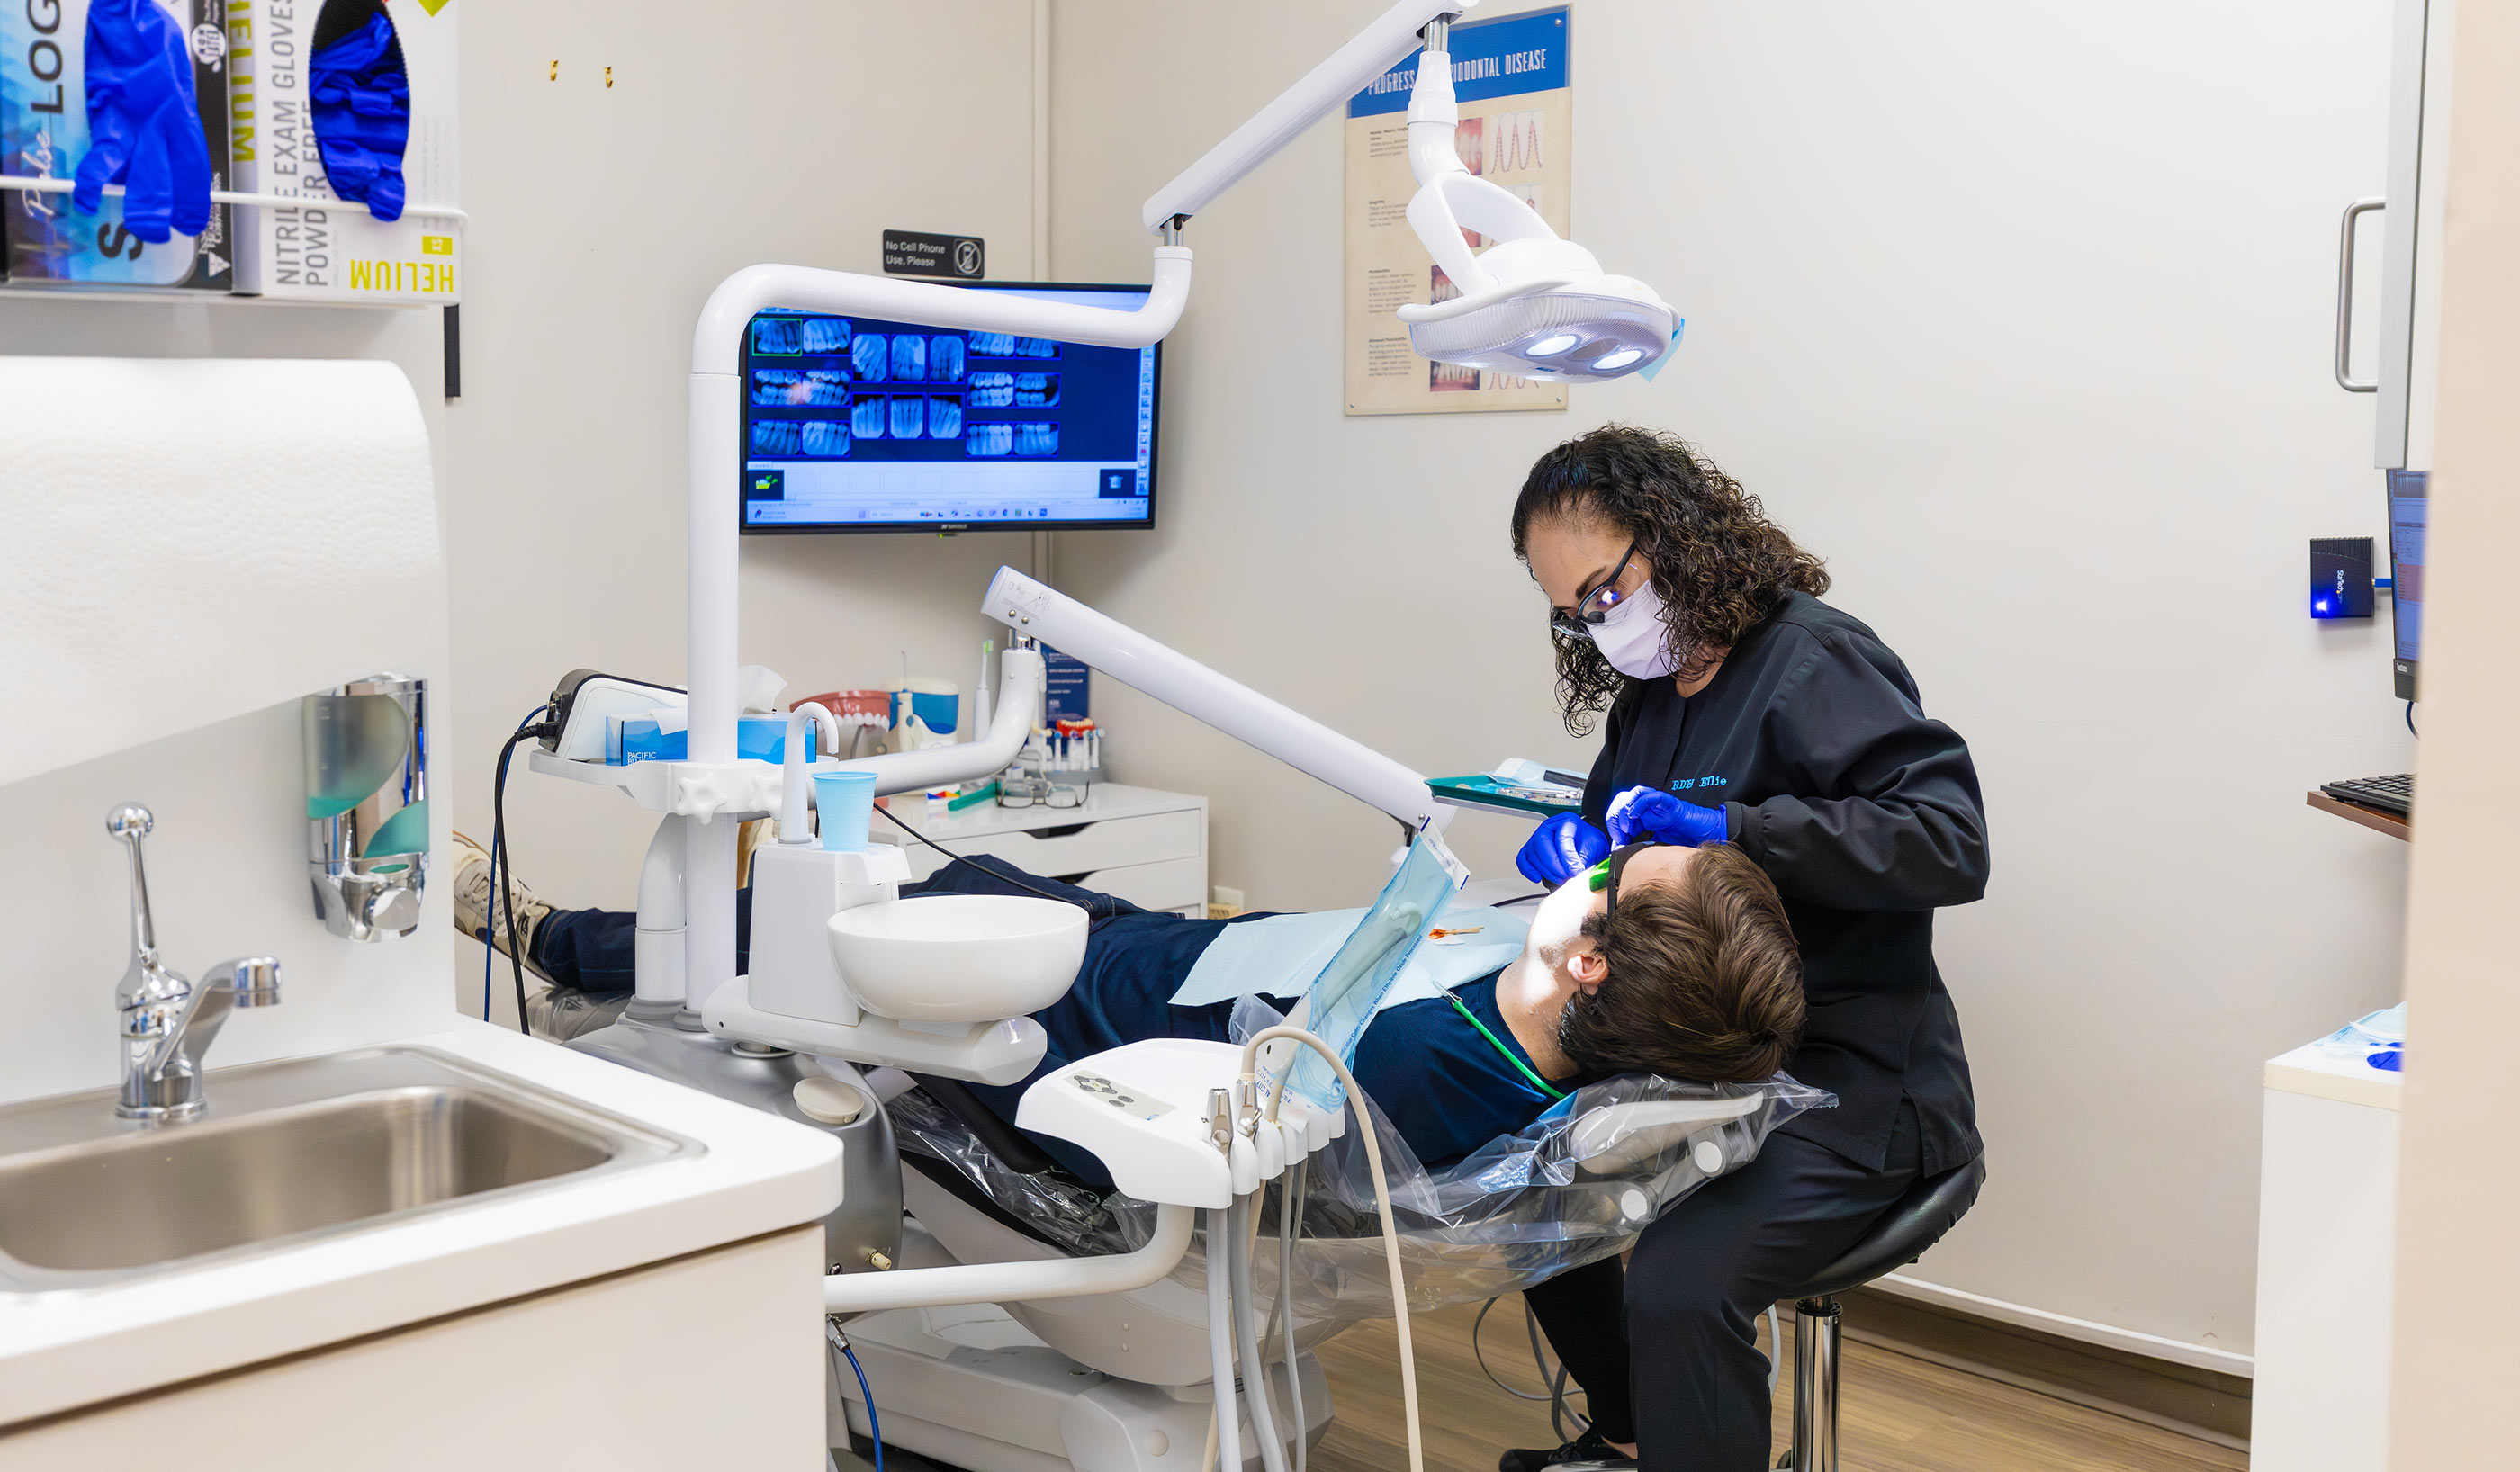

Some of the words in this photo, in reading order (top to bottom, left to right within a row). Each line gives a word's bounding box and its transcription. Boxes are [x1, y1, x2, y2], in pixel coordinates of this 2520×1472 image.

[269, 0, 296, 88] GLOVE
[1505, 49, 1547, 75] DISEASE
[273, 101, 298, 175] EXAM
[22, 129, 54, 217] Plse
[97, 221, 144, 261] S
[303, 175, 328, 286] POWDR
[886, 241, 898, 251] No
[900, 241, 917, 252] Cell
[918, 242, 946, 254] Phone
[350, 259, 454, 292] HELIUM
[886, 255, 905, 265] Use,
[907, 256, 936, 267] Please
[627, 751, 657, 759] PACIFIC
[1359, 1005, 1375, 1026] Changes
[1372, 992, 1384, 1005] When
[1382, 971, 1398, 992] Ethylene
[1396, 957, 1408, 972] Oxide
[1405, 934, 1423, 958] Processed
